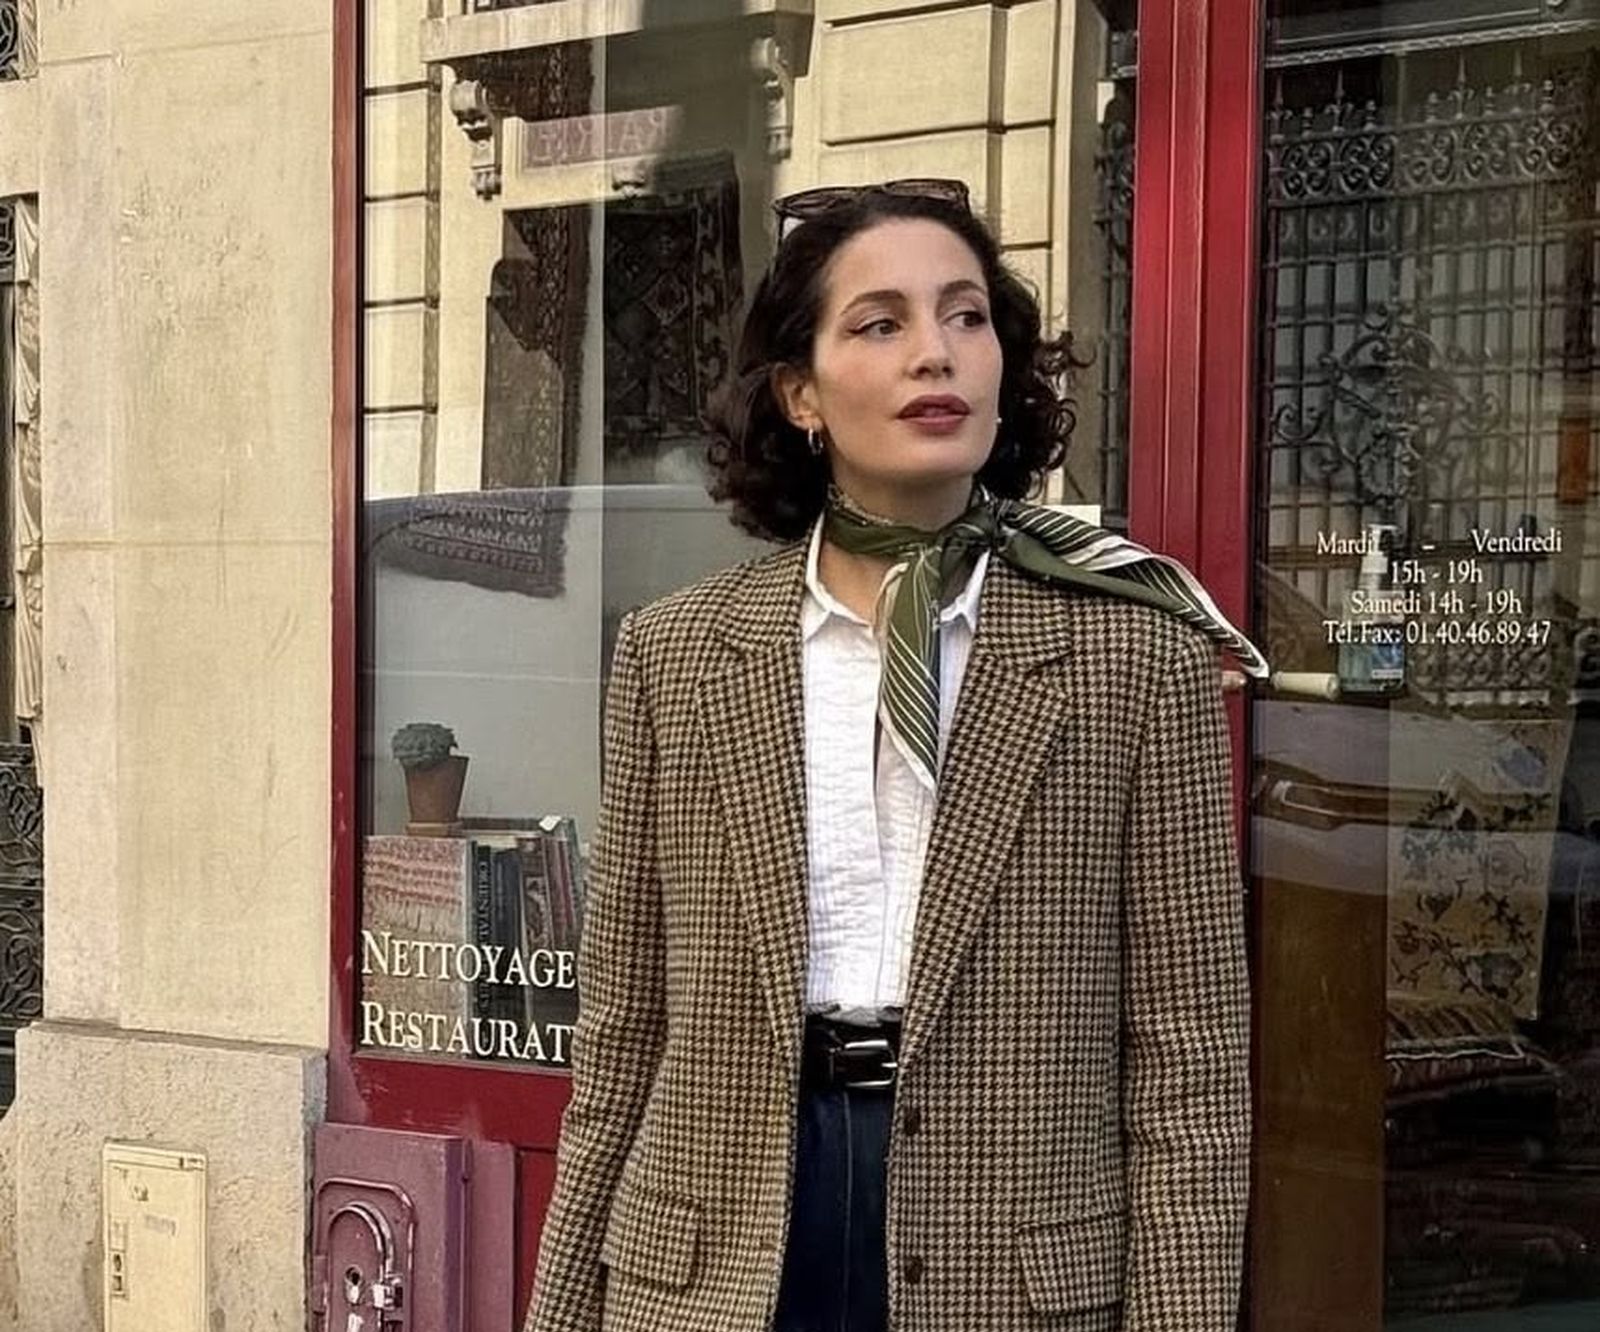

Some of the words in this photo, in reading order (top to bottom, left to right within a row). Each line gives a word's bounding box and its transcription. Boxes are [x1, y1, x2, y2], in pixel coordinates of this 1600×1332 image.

[1317, 531, 1374, 555] Mardi
[1470, 528, 1562, 553] Vendredi
[1391, 560, 1426, 584] 15h
[1447, 560, 1483, 583] 19h
[1351, 590, 1421, 614] Samedi
[1429, 590, 1464, 614] 14h
[1486, 590, 1523, 614] 19h
[1406, 620, 1551, 645] 01.40.46.89.47
[361, 930, 576, 989] NETTOYAGE
